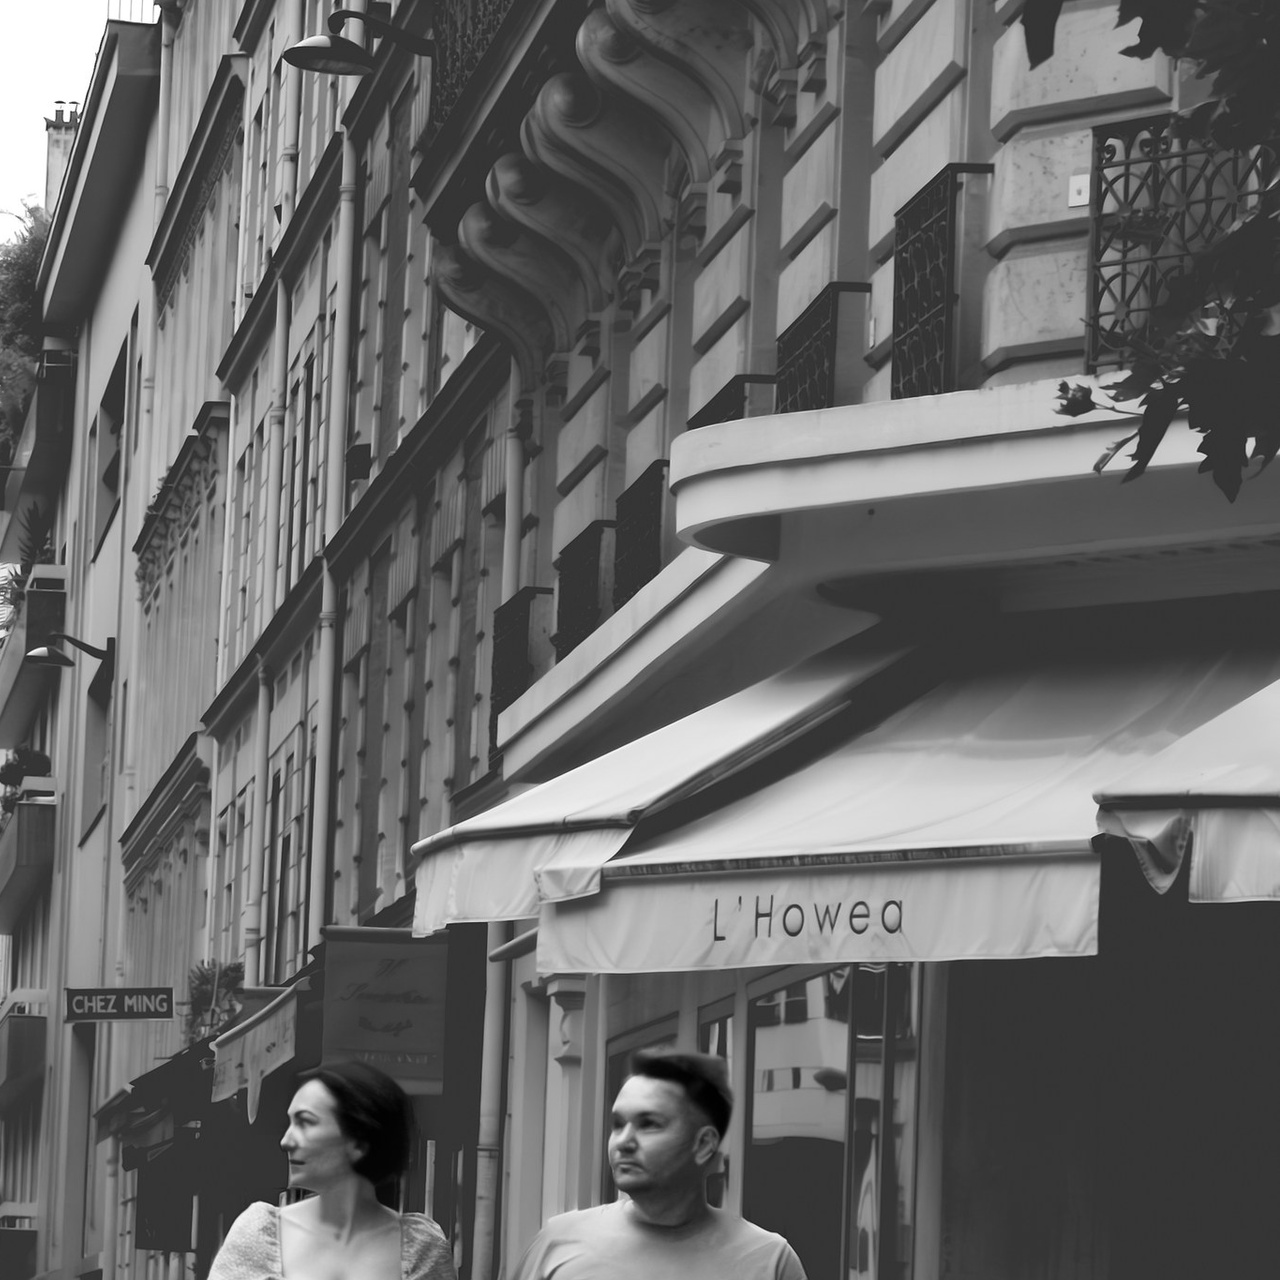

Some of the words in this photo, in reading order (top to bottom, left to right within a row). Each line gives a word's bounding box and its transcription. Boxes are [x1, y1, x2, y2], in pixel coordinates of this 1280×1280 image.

[713, 894, 902, 941] L'Howea
[72, 995, 117, 1013] CHEZ
[124, 994, 168, 1013] MING
